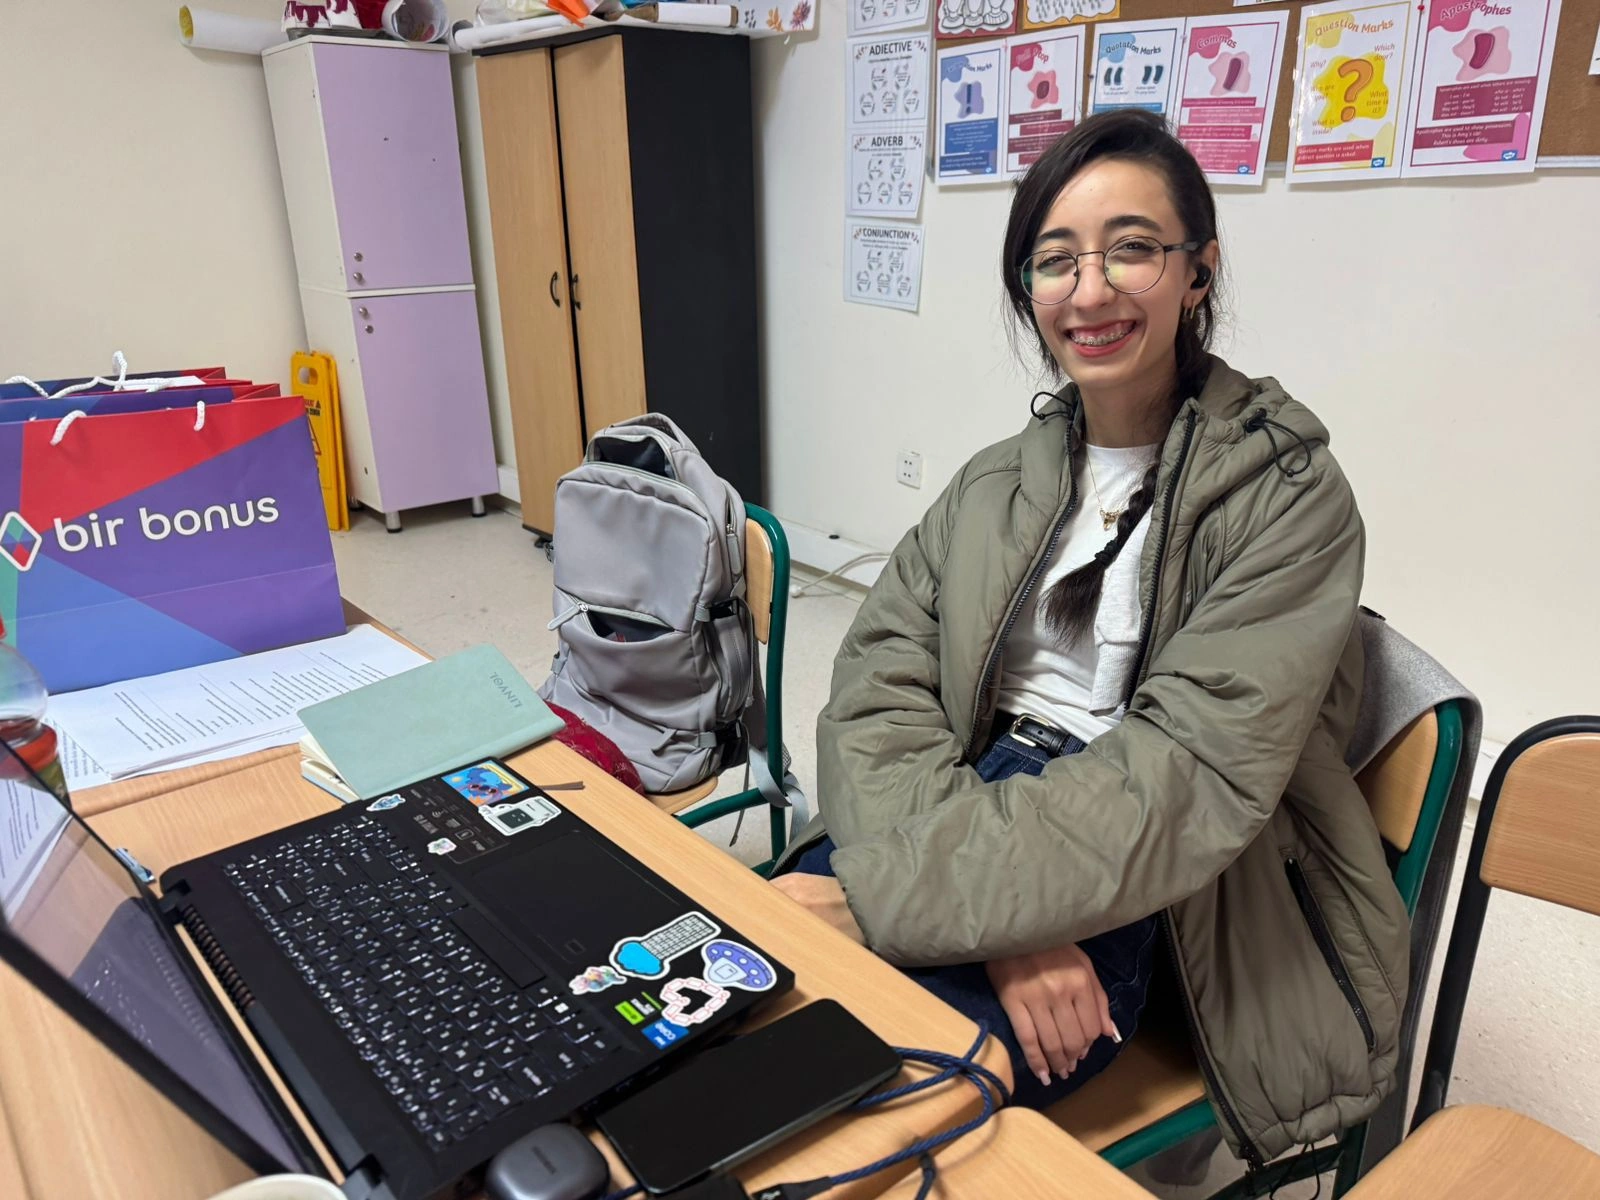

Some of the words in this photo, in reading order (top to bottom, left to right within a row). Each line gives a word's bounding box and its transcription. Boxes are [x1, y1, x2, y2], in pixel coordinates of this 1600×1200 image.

[1440, 1, 1512, 21] Apostrophes
[1315, 17, 1359, 36] Question
[1361, 19, 1394, 33] Marks
[1105, 40, 1139, 54] Quotation
[1140, 46, 1162, 55] Marks
[1197, 34, 1237, 49] Commas
[1374, 43, 1395, 52] Which
[1370, 90, 1388, 98] What
[871, 136, 904, 147] ADVERB
[862, 227, 911, 240] CONJUNCTION
[53, 512, 124, 552] bir
[139, 496, 279, 540] bonus
